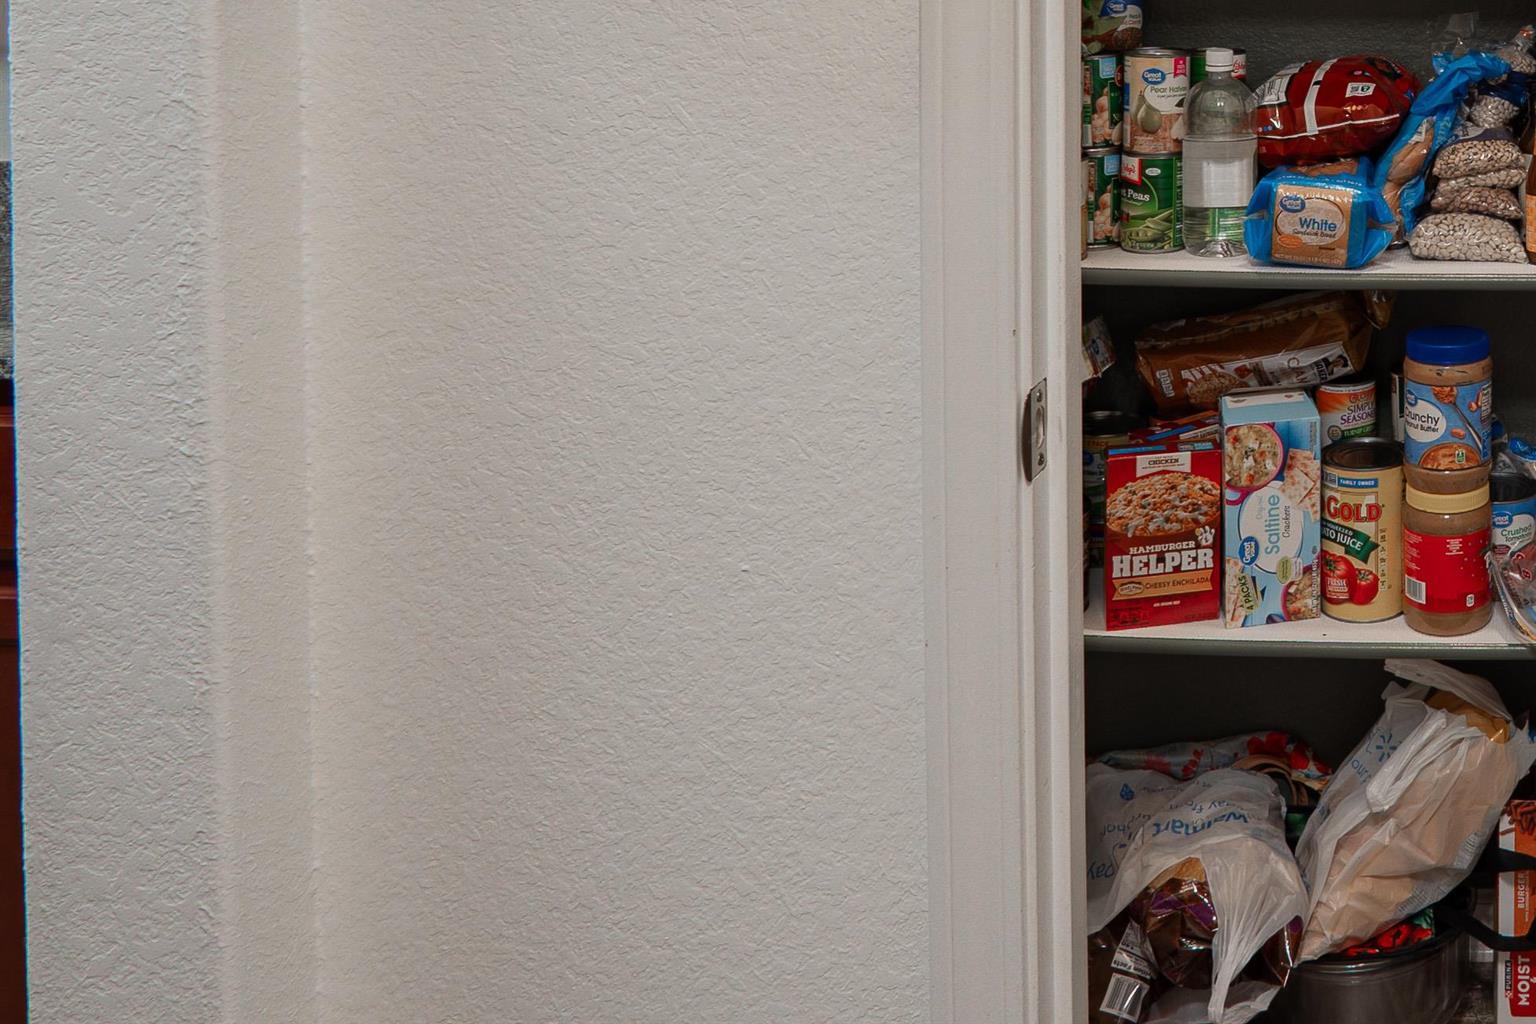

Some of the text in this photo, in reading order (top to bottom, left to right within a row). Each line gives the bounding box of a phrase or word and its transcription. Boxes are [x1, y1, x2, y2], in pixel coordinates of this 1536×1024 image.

[1127, 189, 1151, 202] Peas
[1299, 216, 1337, 232] White
[1319, 230, 1337, 239] Bread
[1340, 409, 1377, 425] SEASONE
[1420, 424, 1440, 433] Butter
[1147, 458, 1180, 466] CHICKEN
[1338, 478, 1355, 486] FAMILY
[1326, 495, 1382, 522] GOLD
[1264, 494, 1280, 556] Saltine
[1282, 505, 1291, 539] Crackers
[1500, 523, 1534, 537] Crushed
[1129, 540, 1196, 555] HAMBURGER
[1336, 532, 1363, 551] JUICE
[1242, 542, 1251, 564] Great
[1111, 548, 1214, 579] HELPER
[1145, 579, 1171, 590] CHEESY
[1171, 577, 1210, 588] ENCHILADA
[1239, 575, 1251, 602] PACKS
[1152, 811, 1248, 837] Walmart
[1517, 954, 1531, 1007] MOIST
